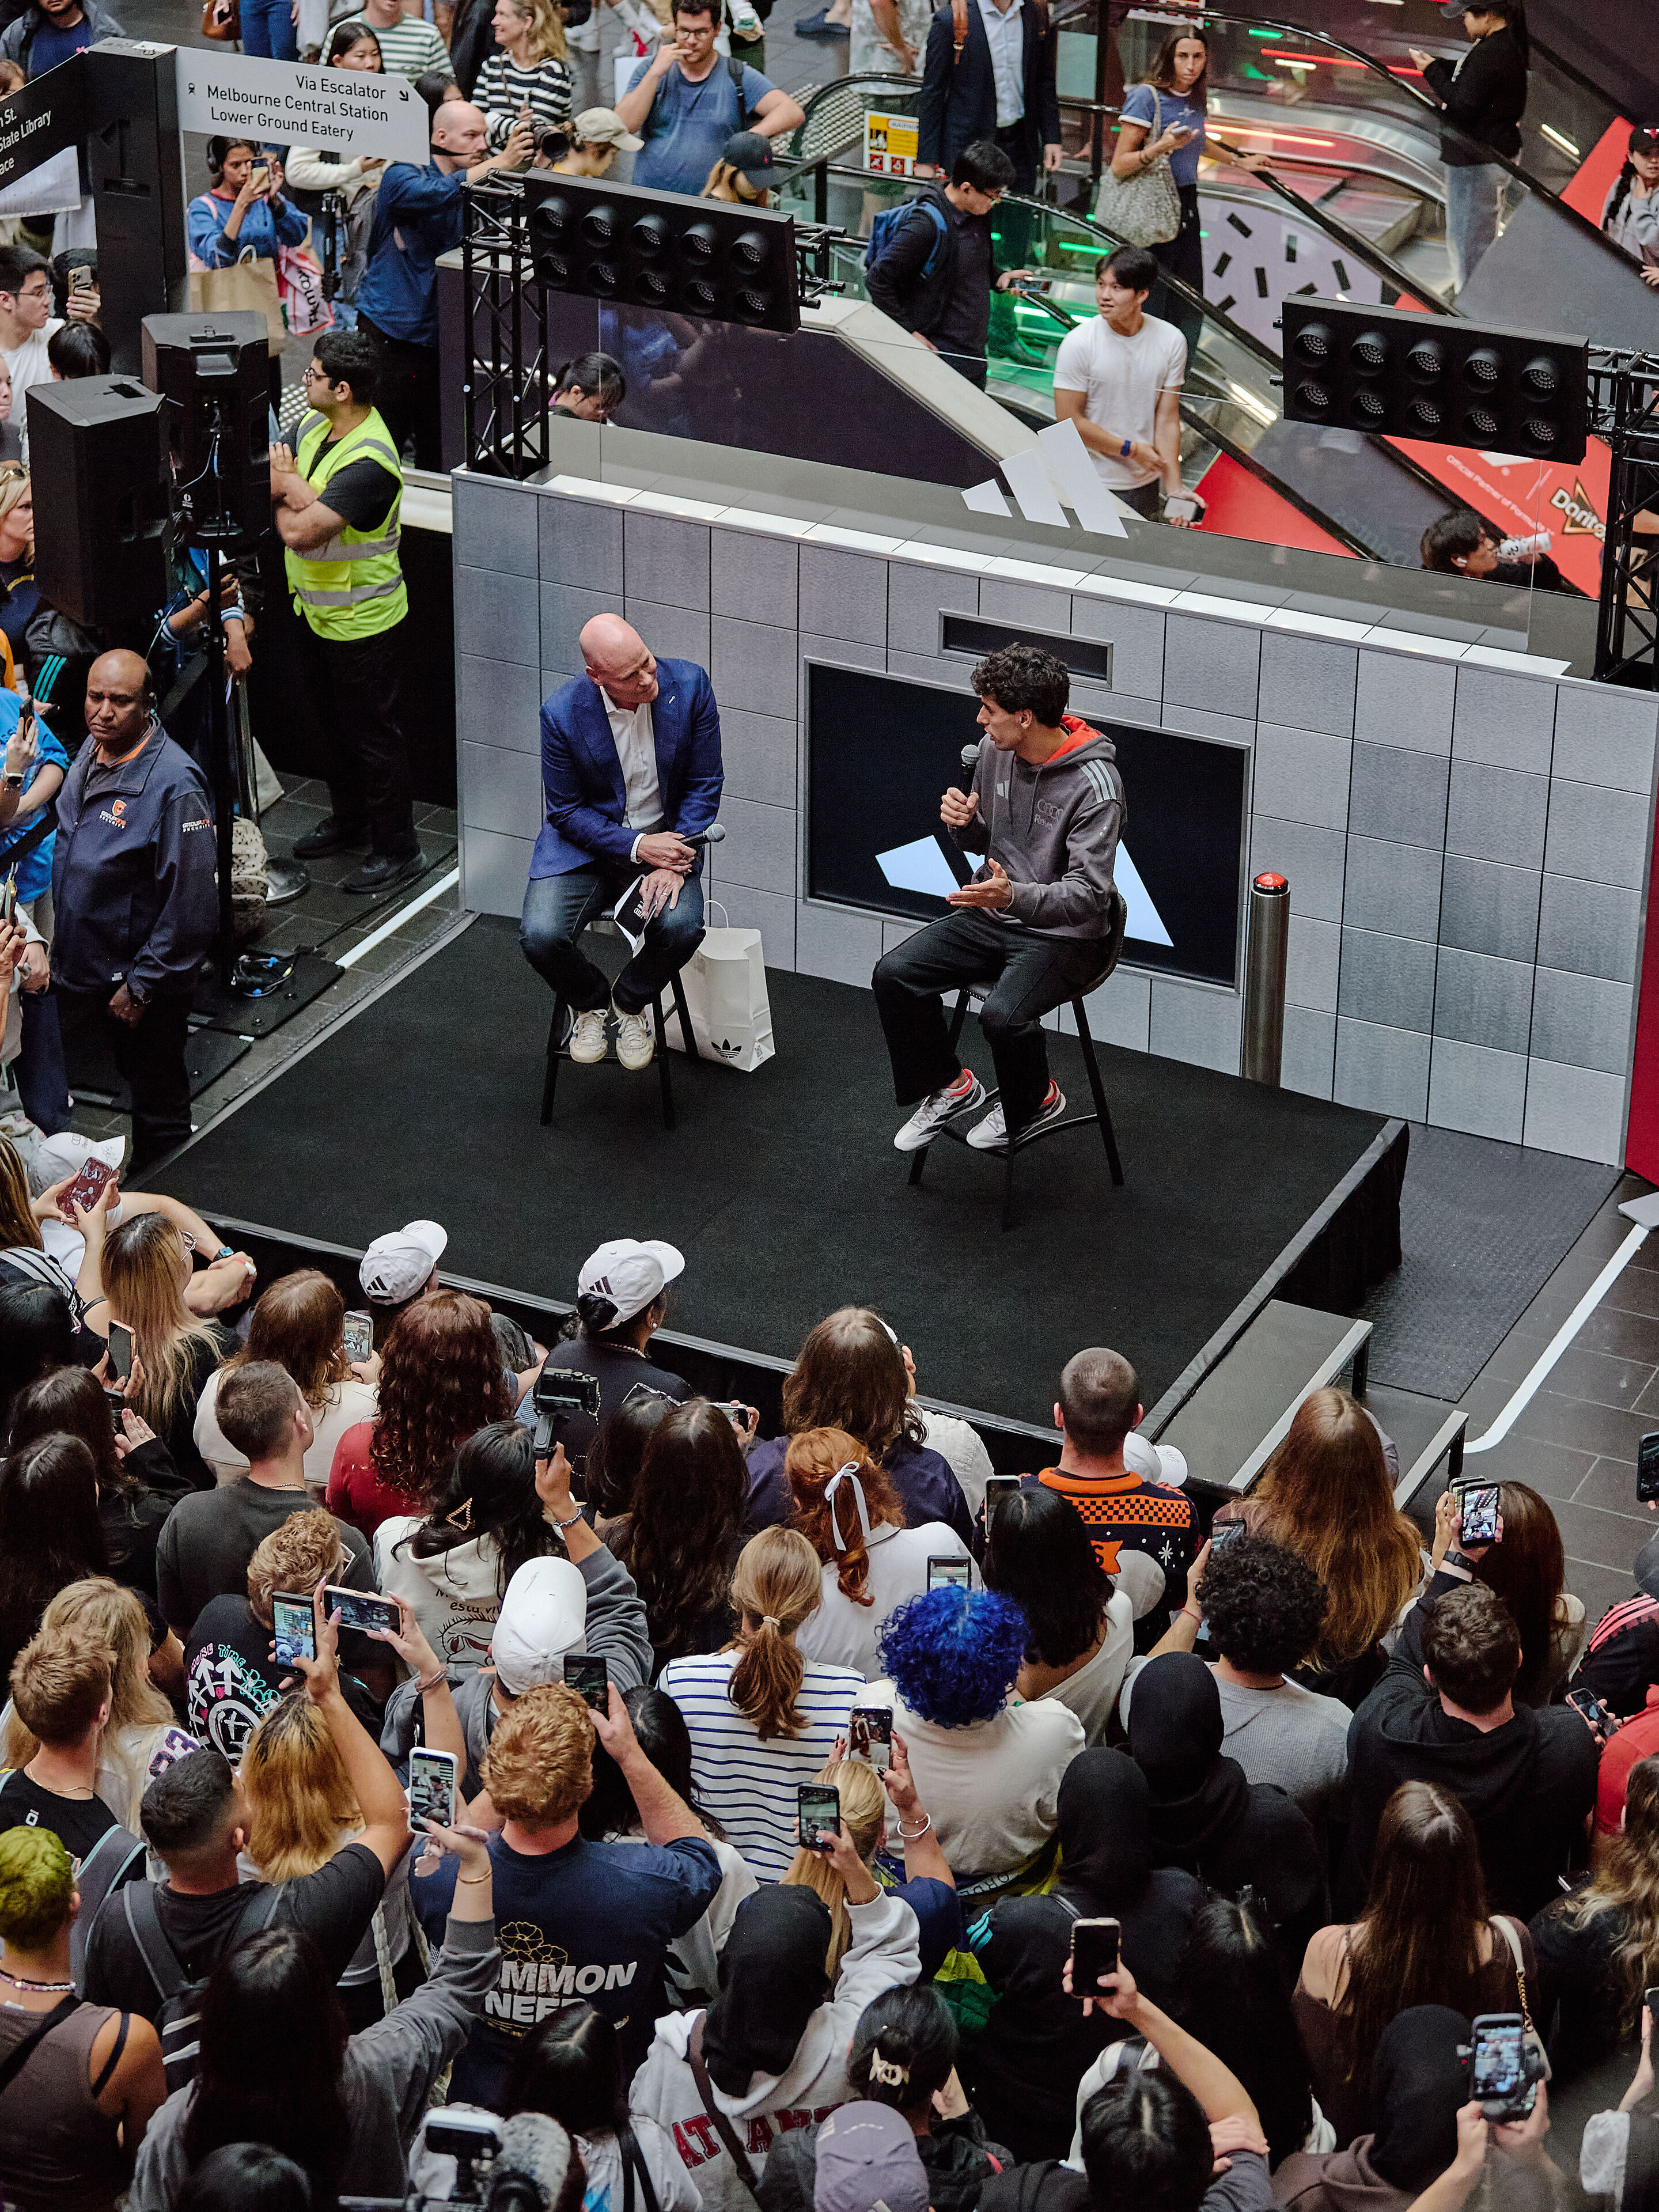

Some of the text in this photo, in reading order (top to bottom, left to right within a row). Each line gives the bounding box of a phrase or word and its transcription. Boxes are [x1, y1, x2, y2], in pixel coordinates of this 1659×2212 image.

[207, 85, 388, 122] Melbourne Central Station
[296, 75, 387, 99] Via Escalator
[20, 110, 51, 138] Library
[211, 107, 354, 142] Lower Ground Eatery
[0, 157, 14, 175] ace
[1550, 487, 1606, 543] Dorito
[499, 1960, 638, 1994] MMON
